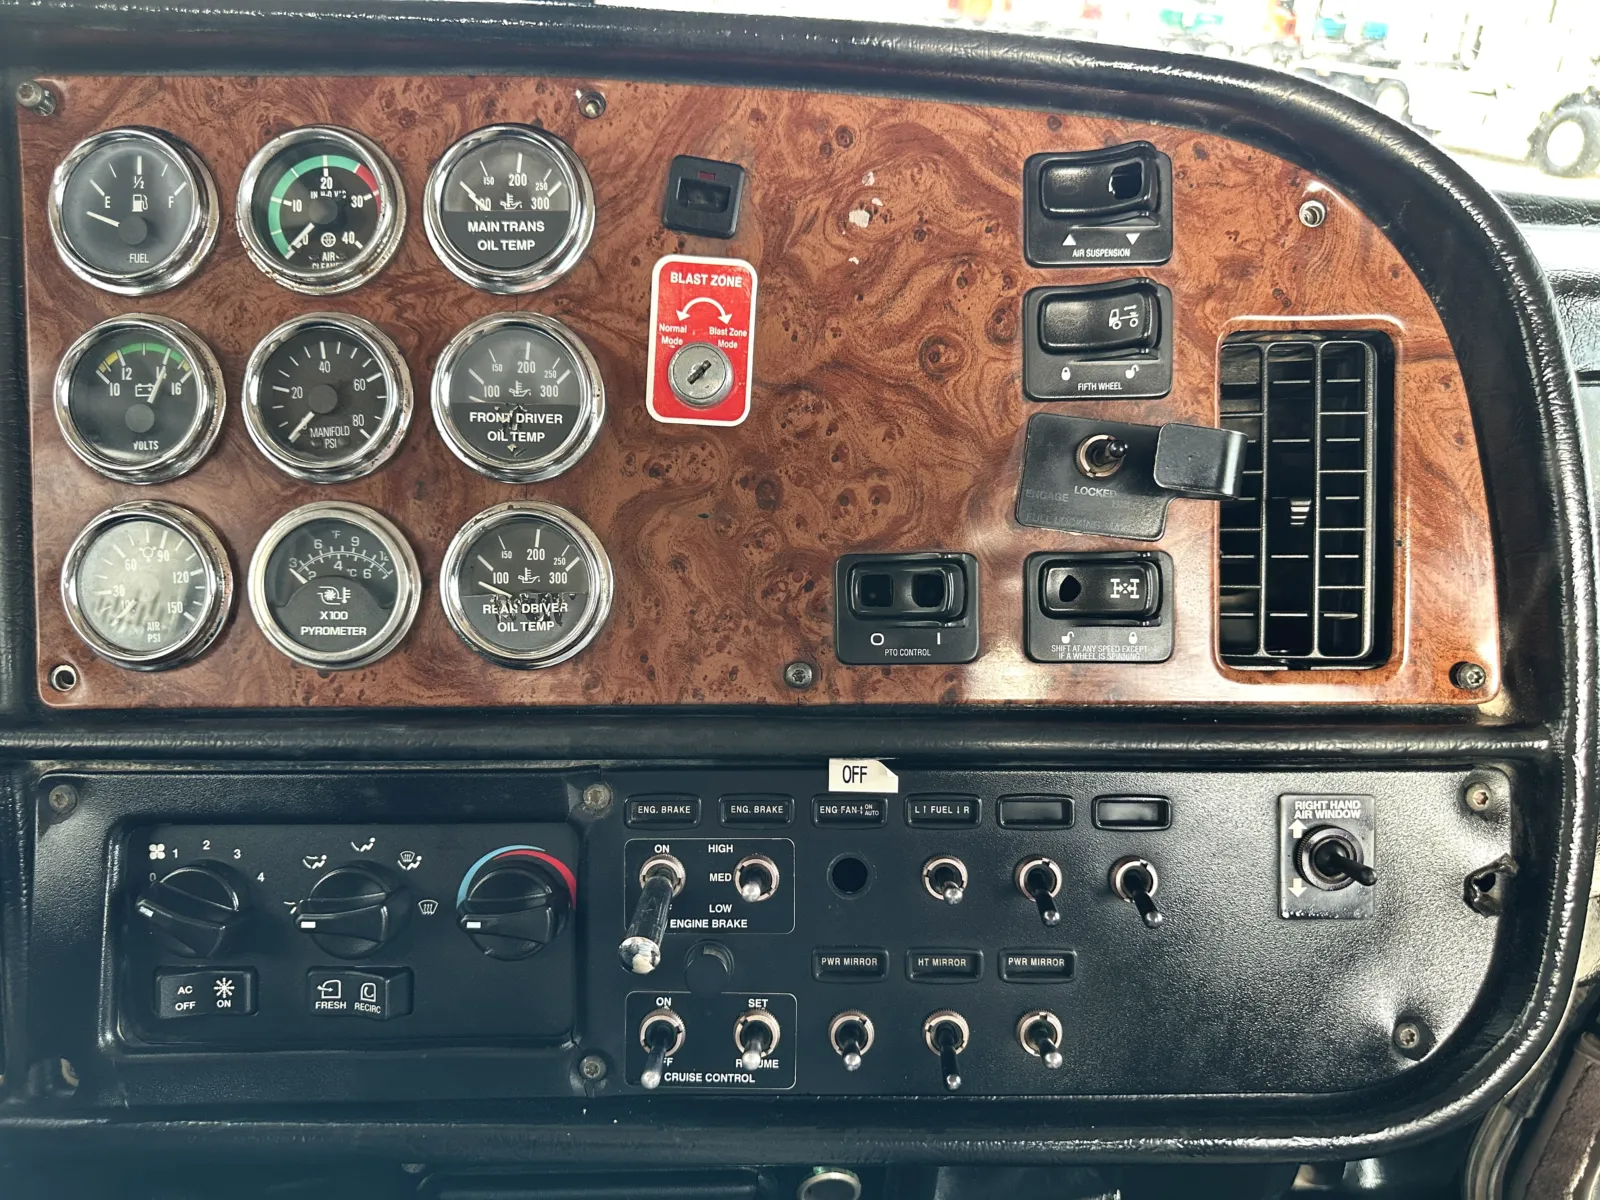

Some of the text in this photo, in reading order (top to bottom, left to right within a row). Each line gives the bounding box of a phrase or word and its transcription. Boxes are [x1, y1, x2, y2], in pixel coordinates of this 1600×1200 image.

[320, 177, 333, 190] 20
[483, 176, 495, 186] 150
[508, 173, 527, 187] 200
[535, 182, 548, 191] 250
[104, 196, 111, 208] E
[168, 196, 175, 208] F
[292, 199, 303, 213] 10
[351, 195, 364, 208] 30
[531, 197, 550, 210] 300
[467, 221, 545, 232] MAIN TRANS
[341, 231, 355, 244] 40
[477, 240, 536, 251] OIL TEMP
[129, 253, 149, 263] FUEL
[322, 252, 336, 261] AIR
[1072, 248, 1131, 257] AIR SUSPENSION
[312, 262, 344, 270] CLEAN
[670, 271, 743, 288] BLAST ZONE
[659, 323, 687, 334] Normal
[709, 326, 747, 337] Blast Zone
[661, 335, 683, 346] Mode
[718, 340, 738, 349] Mode
[319, 361, 331, 373] 40
[492, 363, 503, 372] 150
[517, 361, 536, 373] 200
[121, 367, 132, 381] 12
[544, 370, 557, 379] 250
[109, 382, 121, 396] 10
[171, 382, 182, 396] 16
[353, 378, 366, 391] 60
[1077, 382, 1122, 391] FIFTH WHEEL
[291, 387, 303, 399] 20
[483, 385, 500, 398] 100
[540, 384, 559, 398] 300
[353, 414, 364, 427] 80
[469, 411, 563, 424] FRONT DRIVER
[310, 425, 350, 437] MANIFOLD
[487, 431, 546, 442] OIL TEMP
[133, 440, 159, 450] VOLTS
[325, 439, 337, 449] PSI
[1025, 489, 1069, 502] ENGAGE
[1074, 485, 1117, 498] LOCKED
[314, 539, 323, 550] 6
[351, 536, 360, 547] 9
[157, 549, 170, 563] 90
[501, 551, 512, 559] 150
[526, 548, 546, 561] 200
[124, 558, 137, 571] 60
[289, 557, 298, 569] 3
[333, 560, 343, 571] 4
[553, 557, 566, 566] 250
[173, 571, 189, 584] 120
[308, 571, 317, 581] 2
[363, 568, 372, 580] 6
[493, 571, 510, 585] 100
[549, 571, 568, 585] 300
[112, 584, 125, 597] 30
[167, 601, 183, 614] 150
[483, 602, 569, 615] REAR DRIVER
[147, 621, 160, 631] AIR
[301, 626, 367, 636] PYROMETER
[497, 621, 555, 633] OIL TEMP
[147, 633, 161, 643] PSI
[884, 649, 932, 657] PTO CONTROL
[1051, 644, 1148, 653] SHIFT AT ANY SPEED EXCEPT
[1058, 652, 1065, 660] IF
[1066, 652, 1072, 660] A
[1072, 652, 1097, 660] WHEEL
[842, 765, 868, 784] OFF
[637, 806, 691, 814] ENG. BRAKE
[730, 806, 784, 814] ENG. BRAKE
[819, 806, 858, 814] ENG FAN
[914, 806, 970, 814] L FUEL R
[1294, 800, 1361, 810] RIGHT HAND
[1293, 809, 1361, 819] AIR WINDOW
[202, 840, 211, 850] 2
[654, 844, 670, 853] ON
[708, 844, 734, 853] HIGH
[172, 848, 178, 859] 1
[233, 848, 241, 859] 3
[149, 872, 157, 882] 0
[257, 872, 265, 882] 4
[709, 873, 732, 882] MED
[709, 904, 733, 913] LOW
[669, 919, 748, 928] ENGINE BRAKE
[821, 957, 878, 966] PWR MIRROR
[917, 958, 967, 967] HT MIRROR
[1008, 957, 1065, 967] PWR MIRROR
[177, 985, 193, 995] AC
[175, 1001, 196, 1011] OFF
[216, 999, 232, 1009] ON
[315, 1001, 347, 1010] FRESH
[656, 997, 672, 1006] ON
[748, 998, 768, 1008] SET
[354, 1002, 381, 1014] RECIRC
[735, 1059, 779, 1069] RUME
[664, 1072, 755, 1083] CRUISE CONTROL
